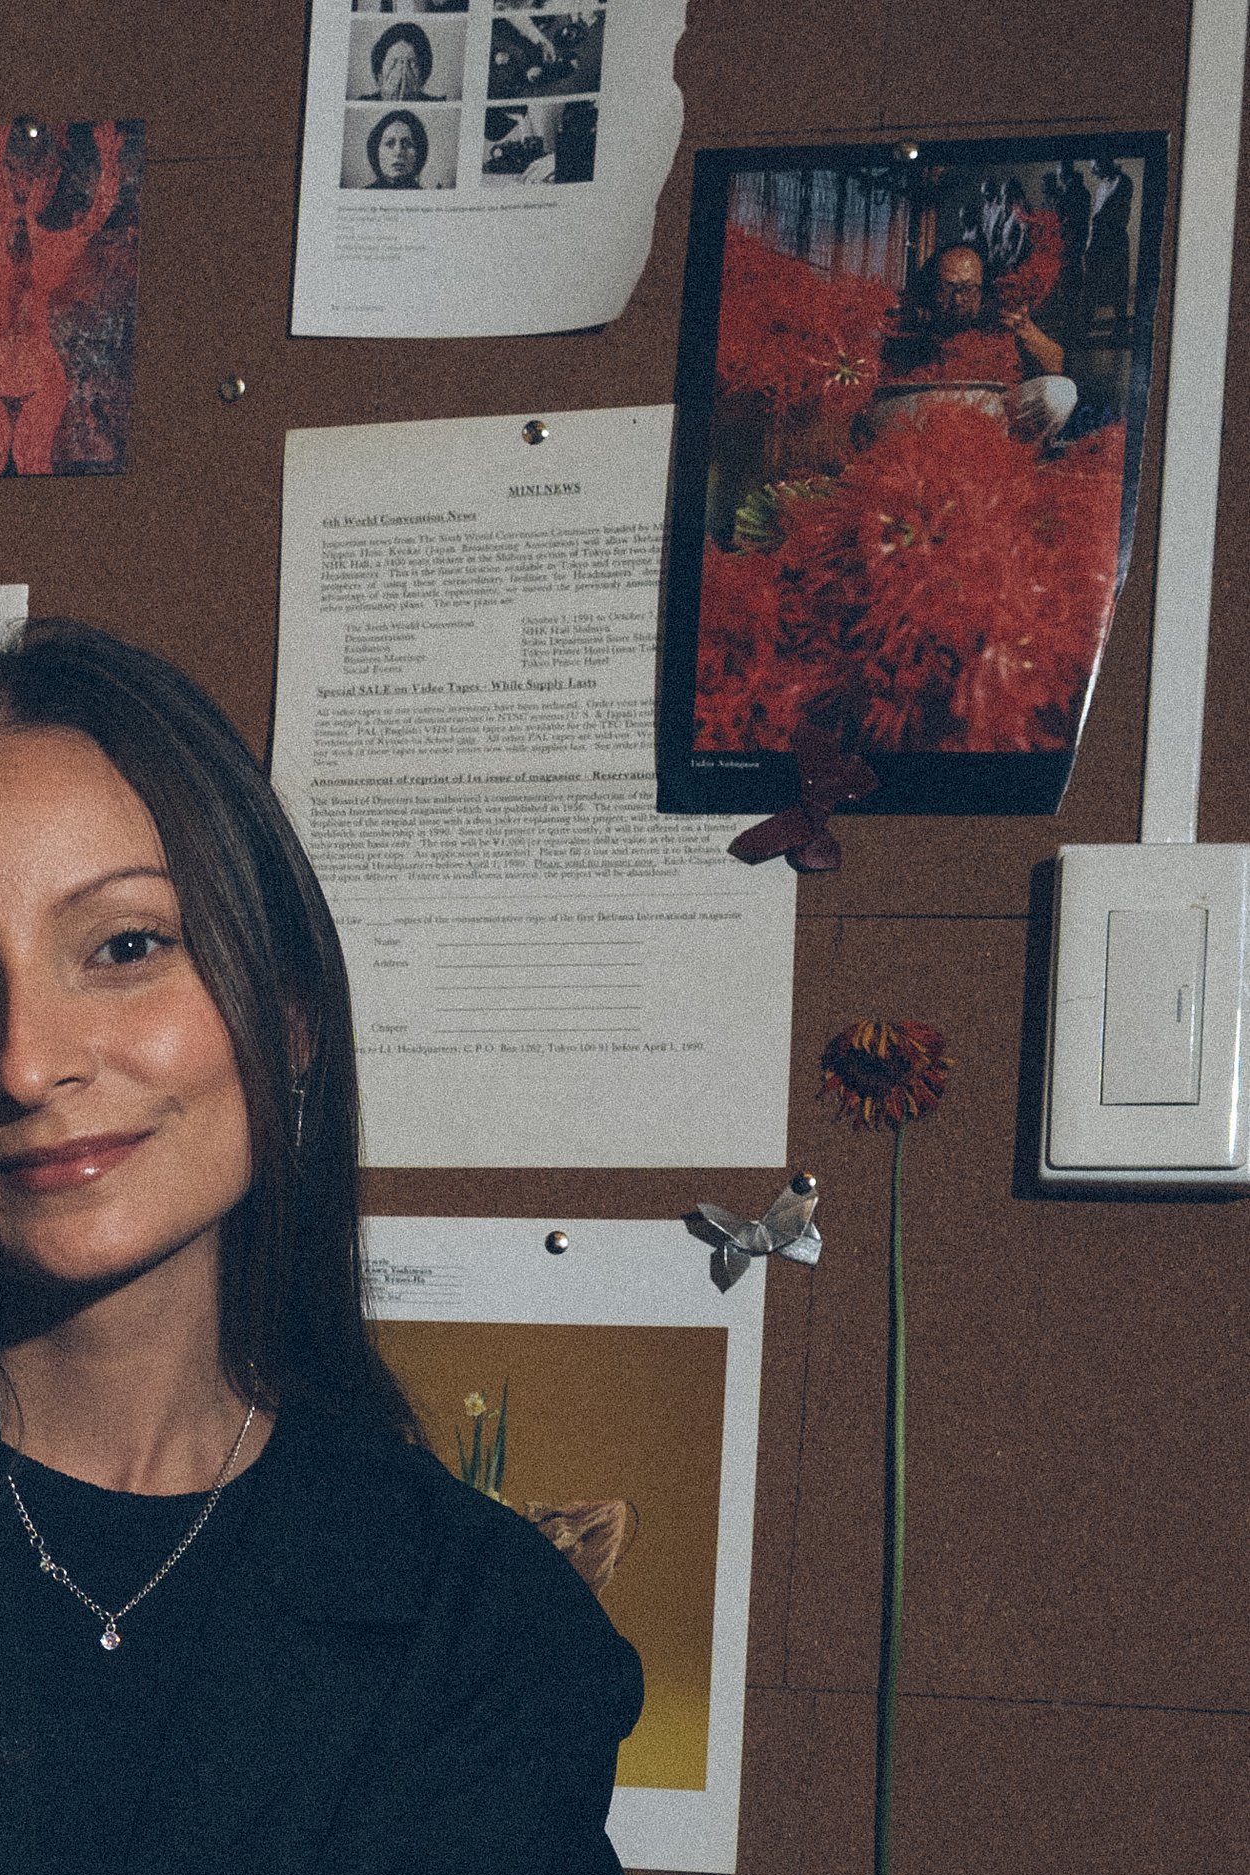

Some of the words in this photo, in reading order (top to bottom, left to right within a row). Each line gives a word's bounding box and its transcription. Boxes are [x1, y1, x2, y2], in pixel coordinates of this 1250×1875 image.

[509, 485, 539, 497] MINI
[545, 482, 580, 494] NEWS
[344, 515, 376, 525] World
[380, 512, 444, 524] Convention
[447, 511, 475, 521] News
[316, 685, 355, 698] Special
[359, 684, 390, 695] SALE
[393, 685, 408, 694] on
[411, 682, 444, 693] Video
[446, 681, 479, 695] Tapes
[490, 680, 522, 691] While
[525, 679, 563, 692] Supply
[566, 678, 596, 689] Lasts
[310, 775, 391, 786] Announcement
[395, 774, 408, 784] of
[409, 774, 449, 786] reprint
[452, 773, 464, 783] of
[514, 772, 527, 781] of
[528, 770, 582, 783] magazine
[373, 937, 400, 945] Name
[372, 959, 408, 967] Address
